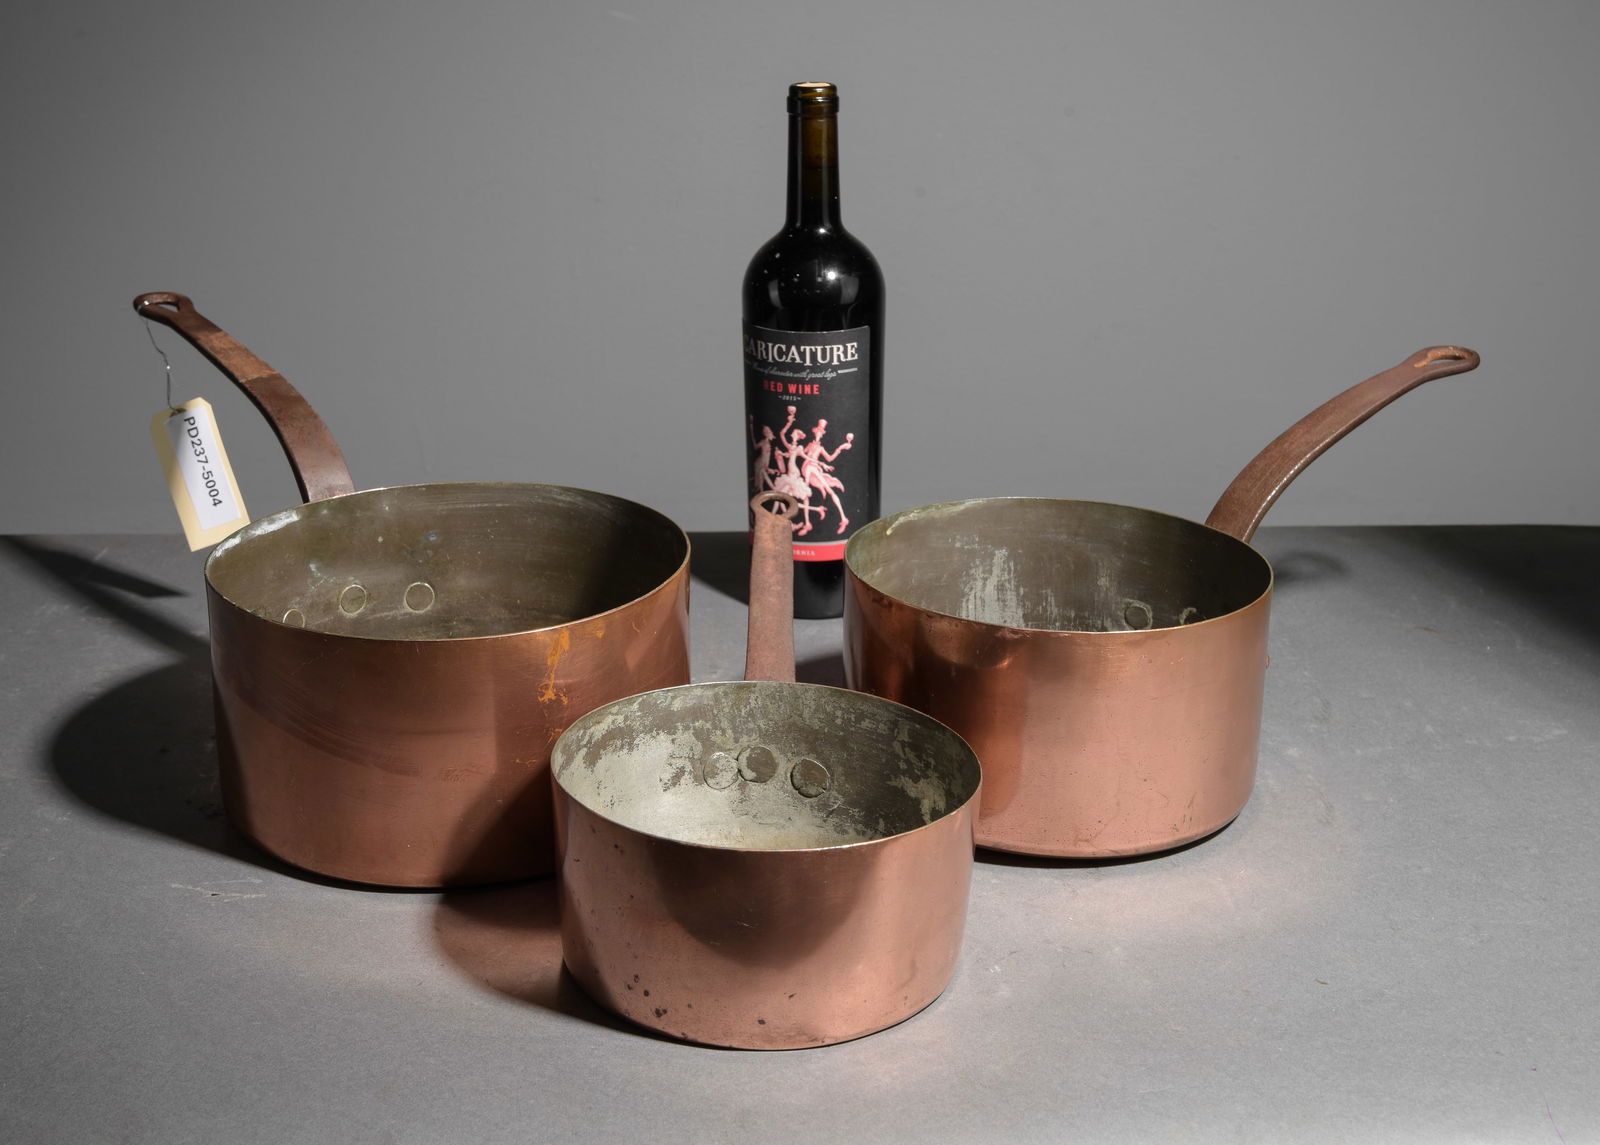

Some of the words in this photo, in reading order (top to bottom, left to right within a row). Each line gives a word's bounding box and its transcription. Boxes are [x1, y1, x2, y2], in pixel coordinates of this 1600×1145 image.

[763, 380, 783, 392] RED
[788, 384, 820, 395] WINE
[184, 416, 223, 507] PD237-5004
